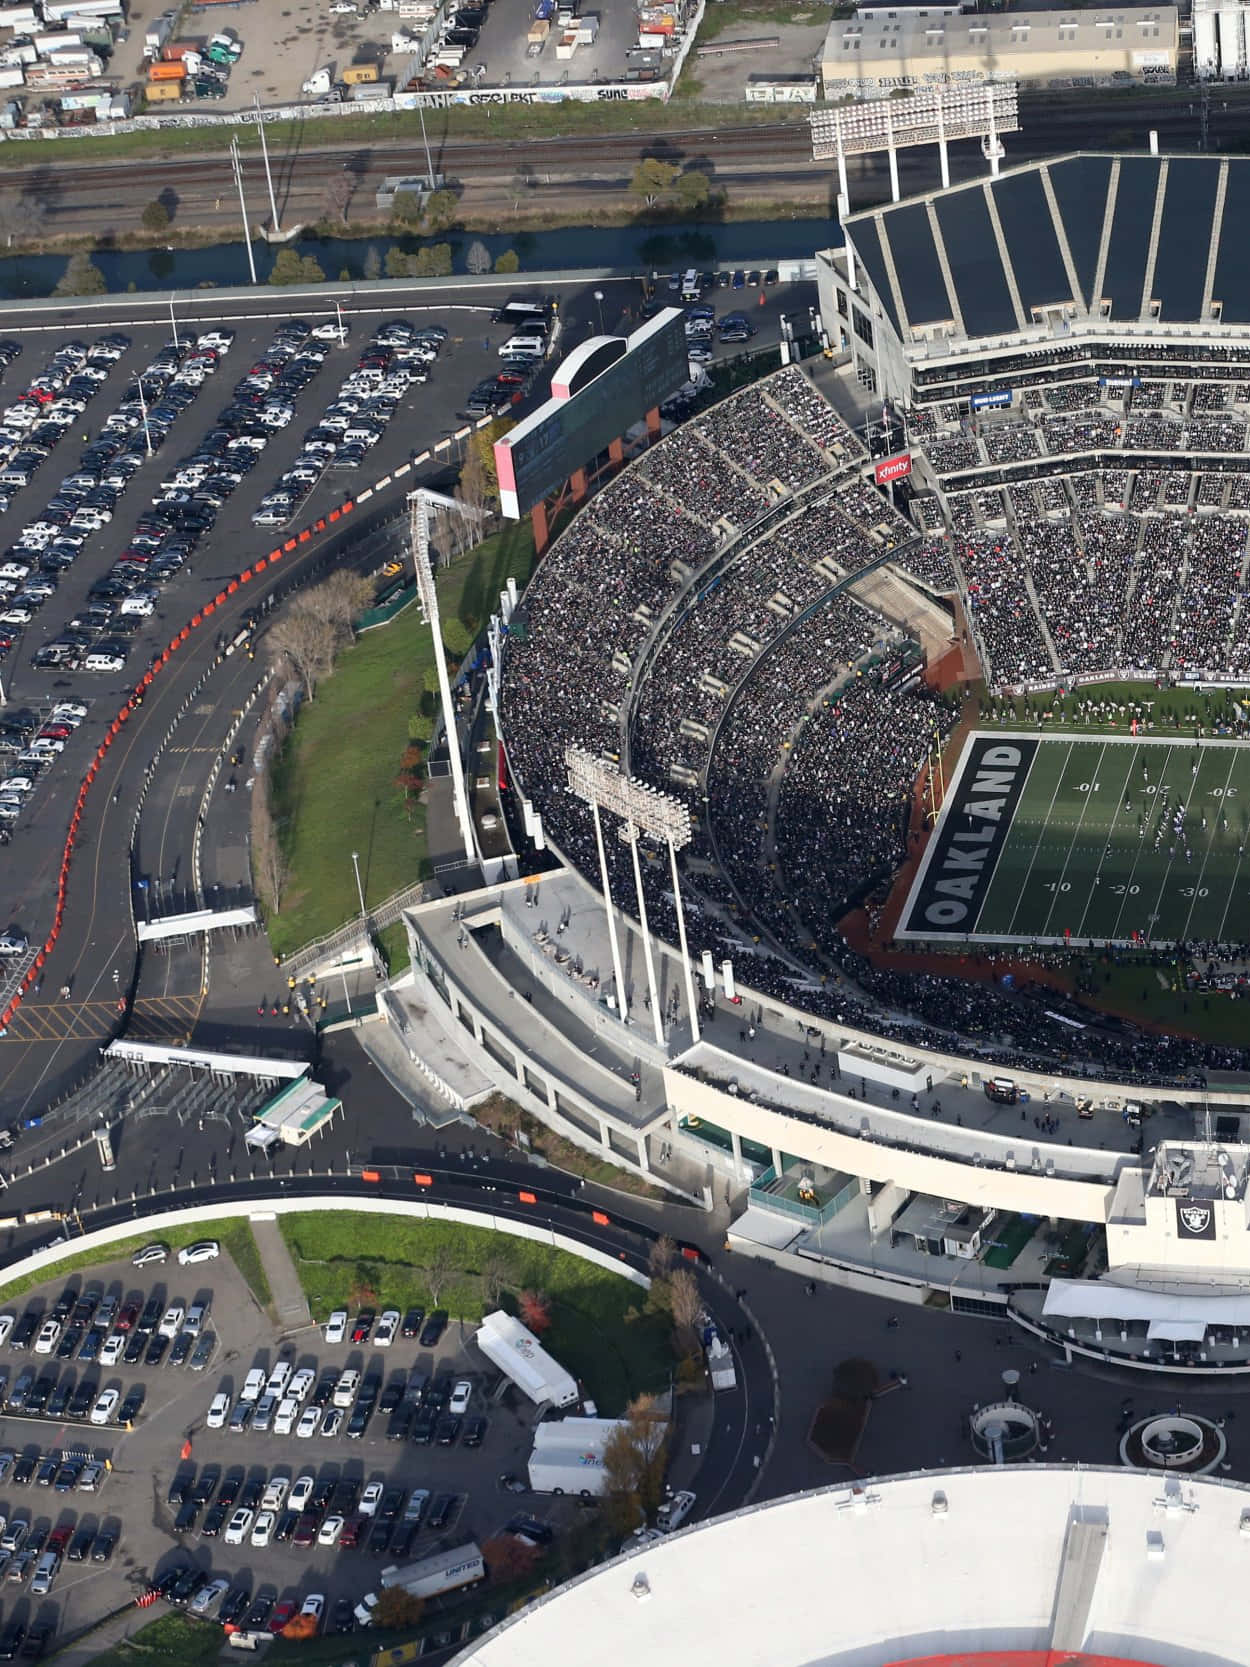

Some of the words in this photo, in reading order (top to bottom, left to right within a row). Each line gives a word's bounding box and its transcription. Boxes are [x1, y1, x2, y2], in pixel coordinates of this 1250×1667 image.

[879, 461, 909, 479] xfinity
[1078, 672, 1116, 683] OAKLAND
[924, 745, 1022, 925] OAKLAND
[1050, 882, 1071, 892] 10
[1115, 885, 1140, 895] 20
[1183, 887, 1209, 897] 30
[445, 1559, 480, 1577] UNITED
